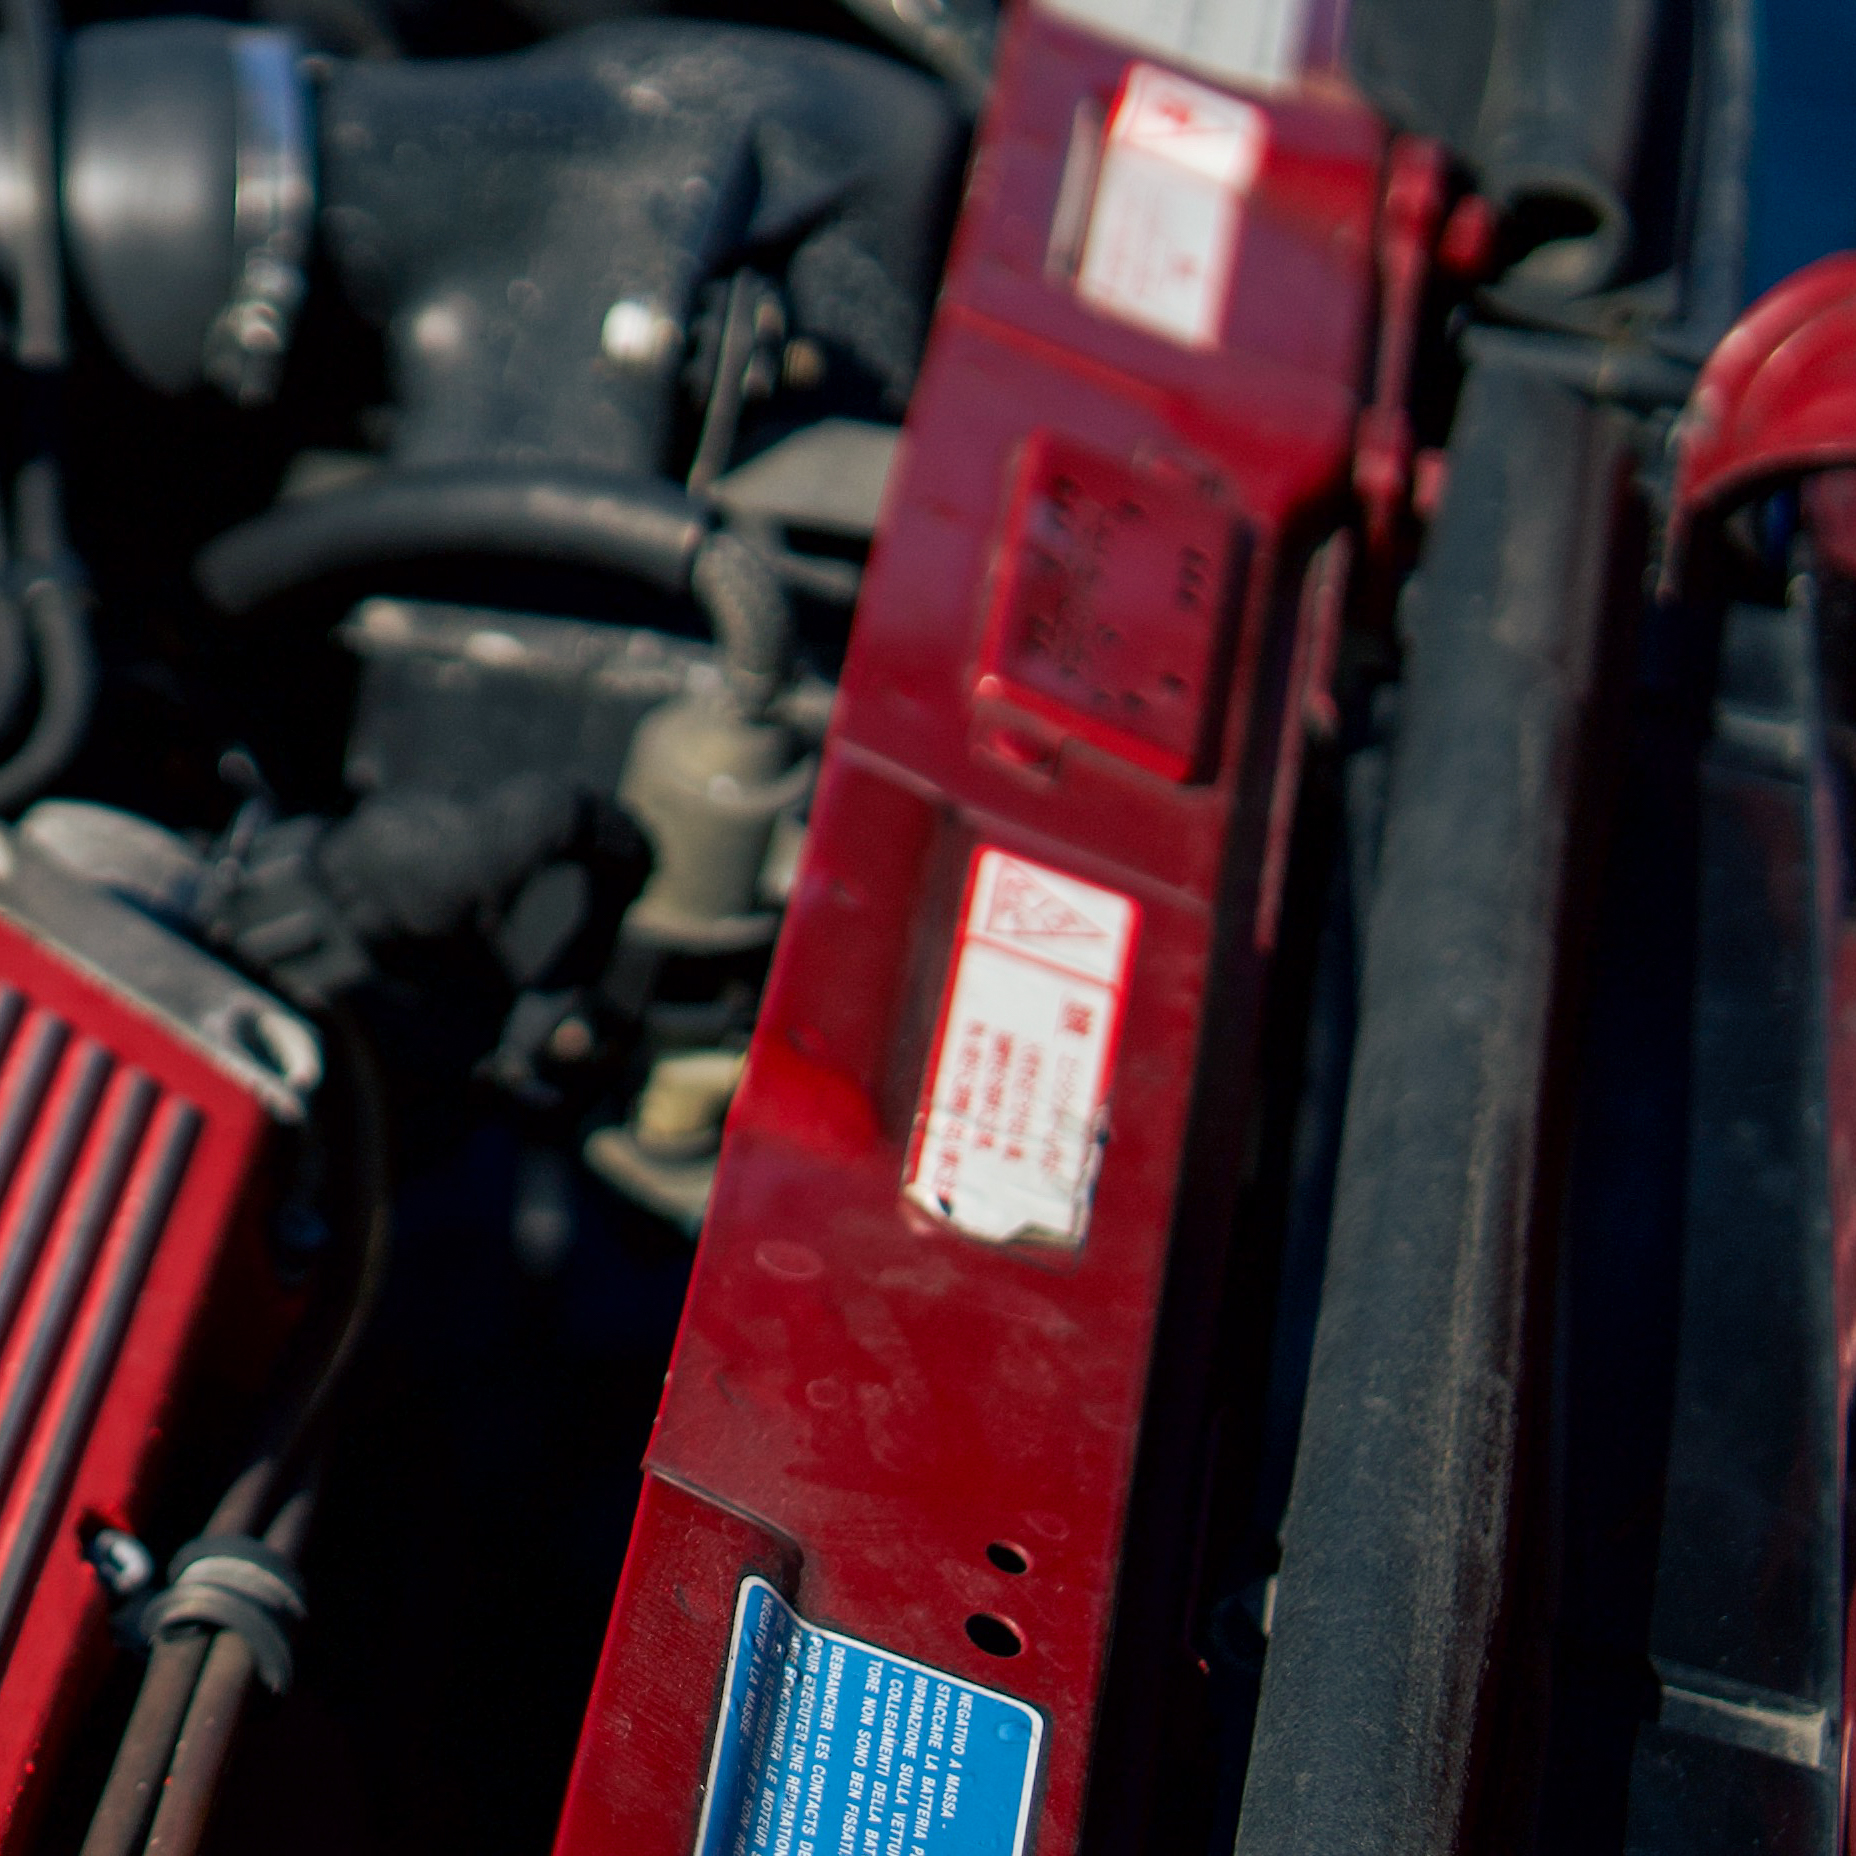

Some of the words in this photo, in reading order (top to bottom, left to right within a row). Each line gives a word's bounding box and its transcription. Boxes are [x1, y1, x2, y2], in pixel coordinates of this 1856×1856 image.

[747, 1666, 760, 1686] LA
[804, 1633, 823, 1675] POUR
[864, 1656, 883, 1695] TORE
[737, 1687, 756, 1737] MASSE
[768, 1664, 797, 1762] FONCTIONNER
[792, 1672, 819, 1744] EXÉCUTER
[859, 1695, 876, 1727] NON
[874, 1676, 903, 1777] COLLEGAMENTI
[902, 1673, 929, 1760] RIPARAZIONE
[927, 1681, 951, 1750] STACCARE
[950, 1689, 973, 1757] NEGATIVO
[787, 1741, 805, 1774] UNE
[813, 1731, 830, 1761] LES
[851, 1726, 871, 1769] SONO
[923, 1752, 940, 1773] LA
[744, 1771, 758, 1792] ET
[764, 1763, 780, 1784] LE
[846, 1769, 864, 1800] BEN
[894, 1761, 914, 1808] SULLA
[940, 1772, 960, 1821] MASSA
[738, 1794, 754, 1829] SON
[752, 1785, 776, 1848] MOTEUR
[800, 1761, 825, 1837] CONTACTS
[866, 1779, 886, 1825] DELLA
[912, 1774, 936, 1842] BATTERIA
